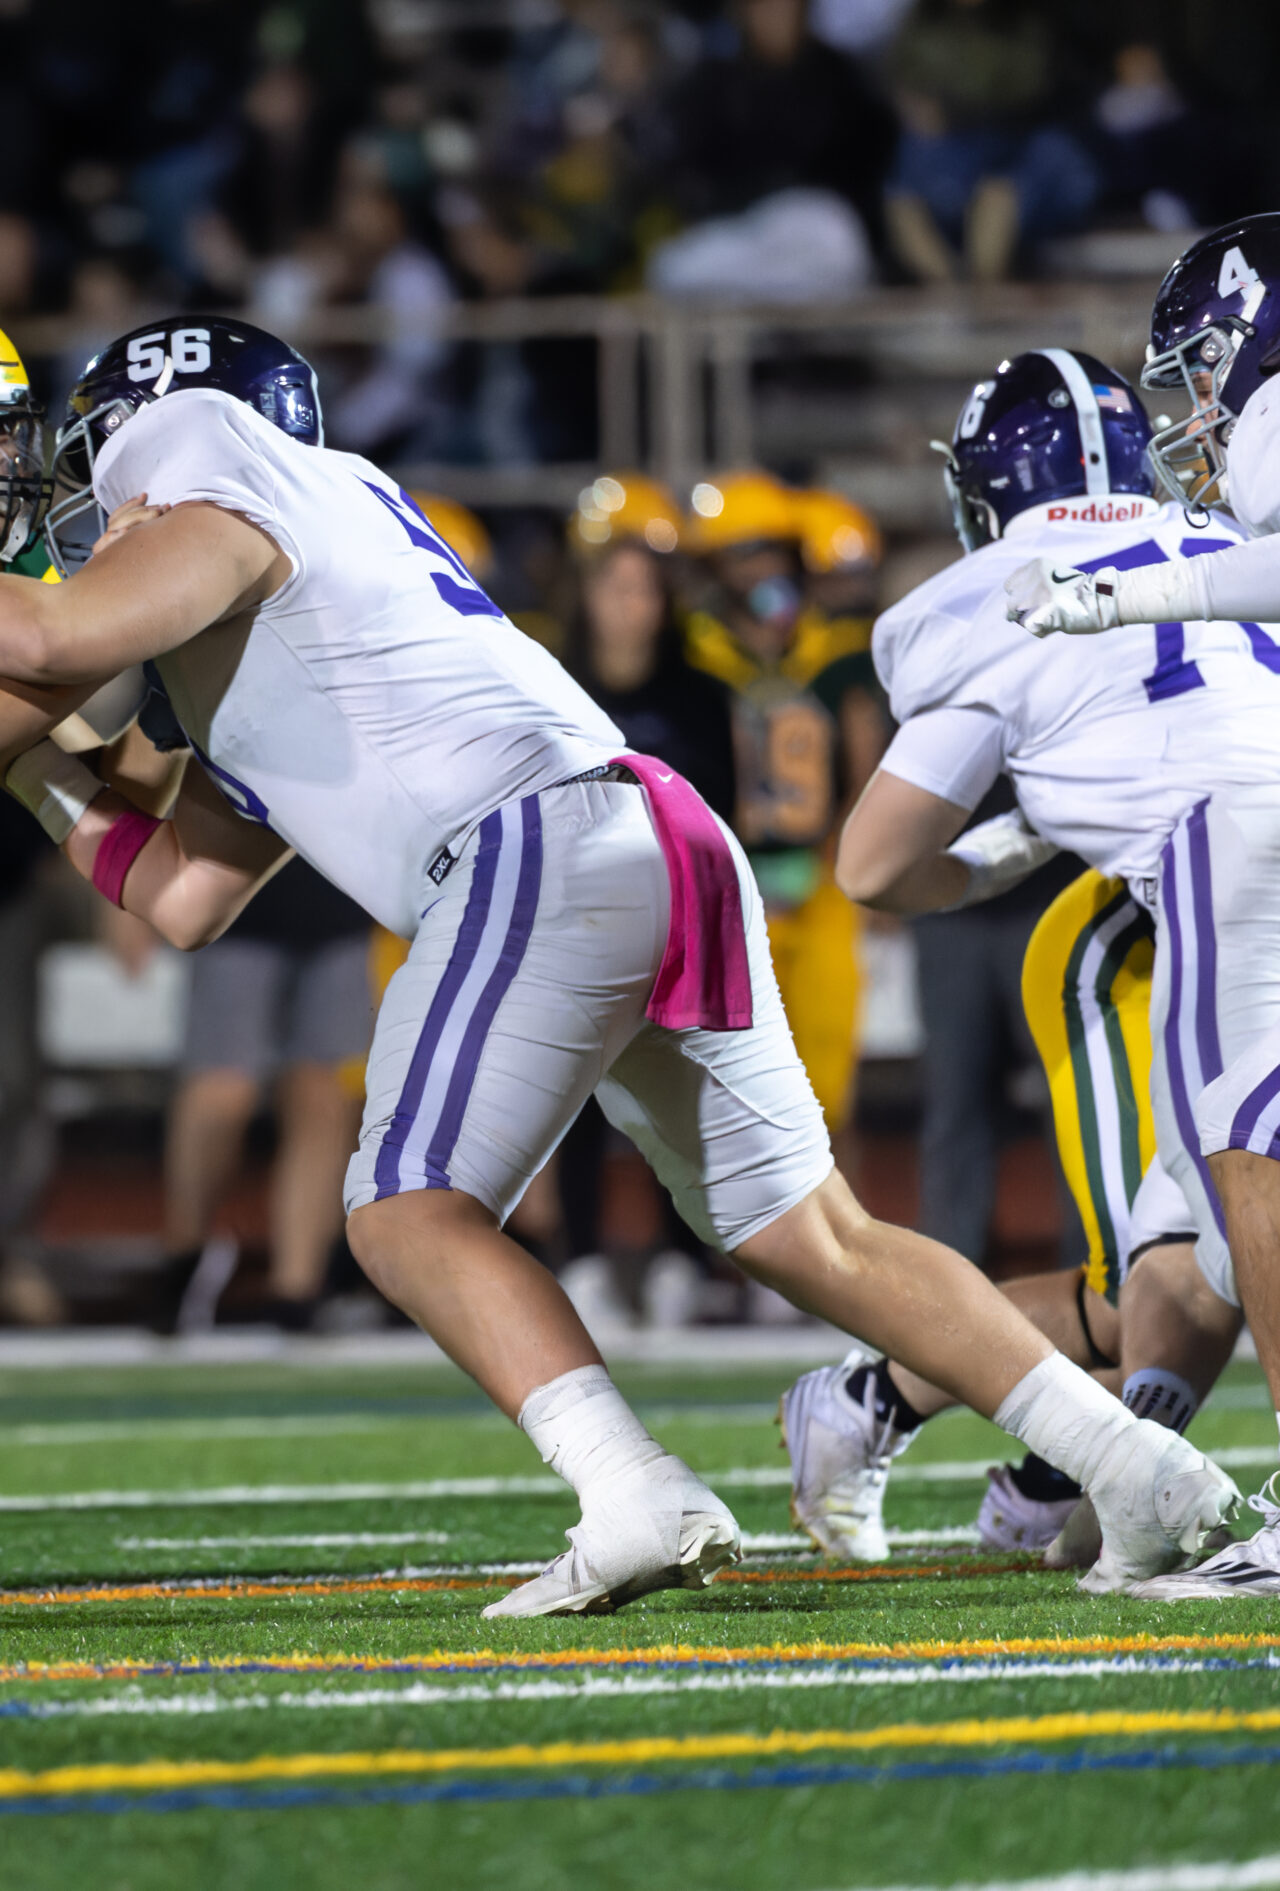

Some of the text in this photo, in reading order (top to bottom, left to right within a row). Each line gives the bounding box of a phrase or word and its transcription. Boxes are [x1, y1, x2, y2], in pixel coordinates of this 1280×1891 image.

[1217, 245, 1260, 303] 4
[126, 327, 211, 383] 56
[953, 380, 997, 445] 6
[1047, 502, 1144, 523] Riddell
[431, 856, 452, 883] 2XL
